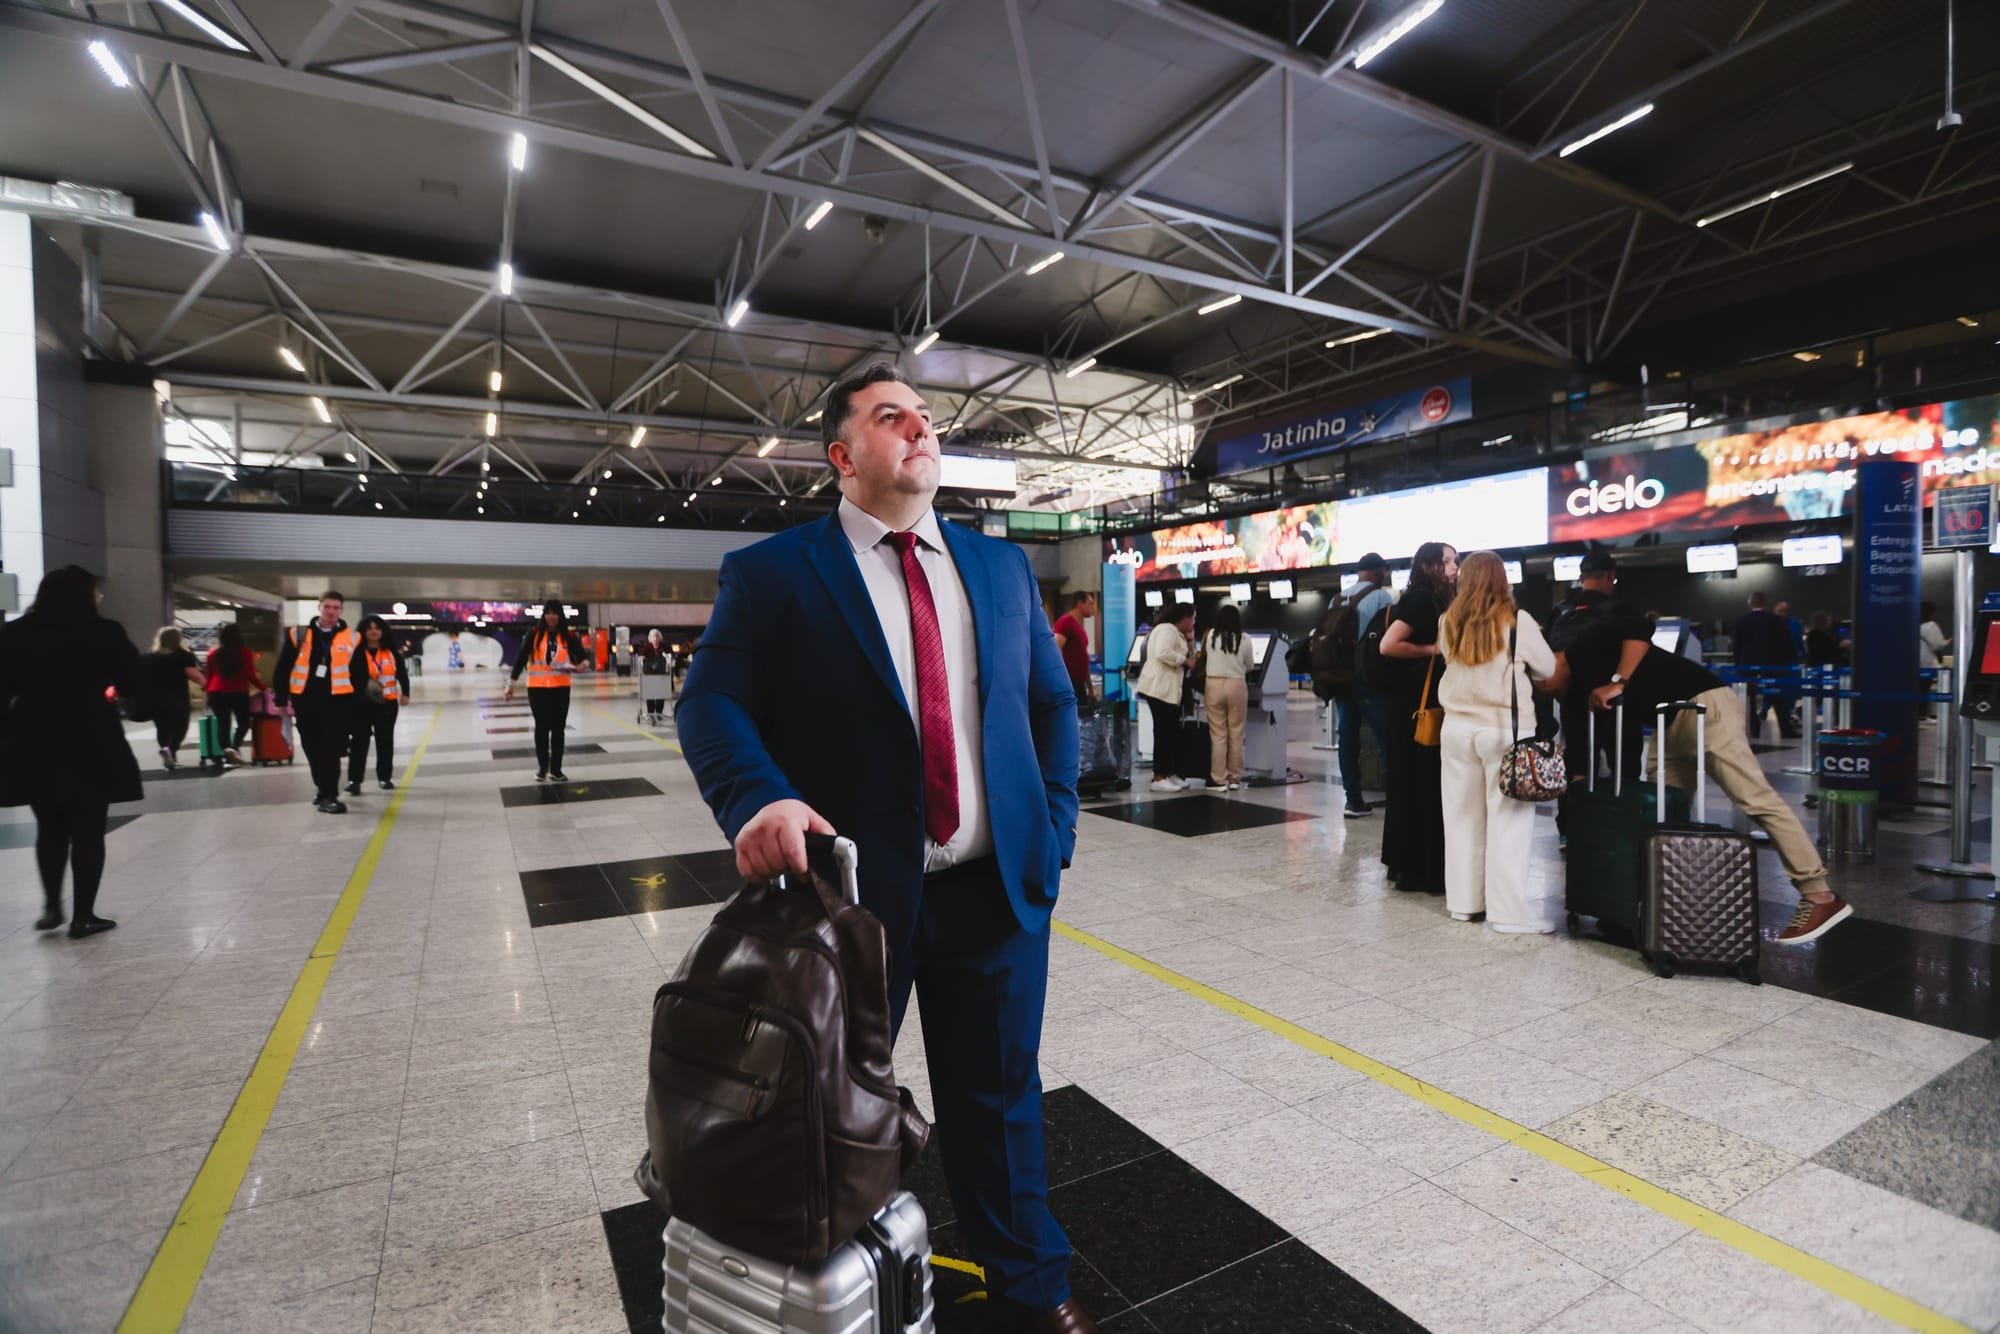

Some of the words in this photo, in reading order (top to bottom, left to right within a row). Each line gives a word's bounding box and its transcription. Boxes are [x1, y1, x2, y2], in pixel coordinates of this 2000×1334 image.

[1258, 417, 1346, 453] Jatinho
[1566, 474, 1665, 516] cielo
[1944, 508, 1983, 532] 60
[1823, 756, 1870, 772] CCR
